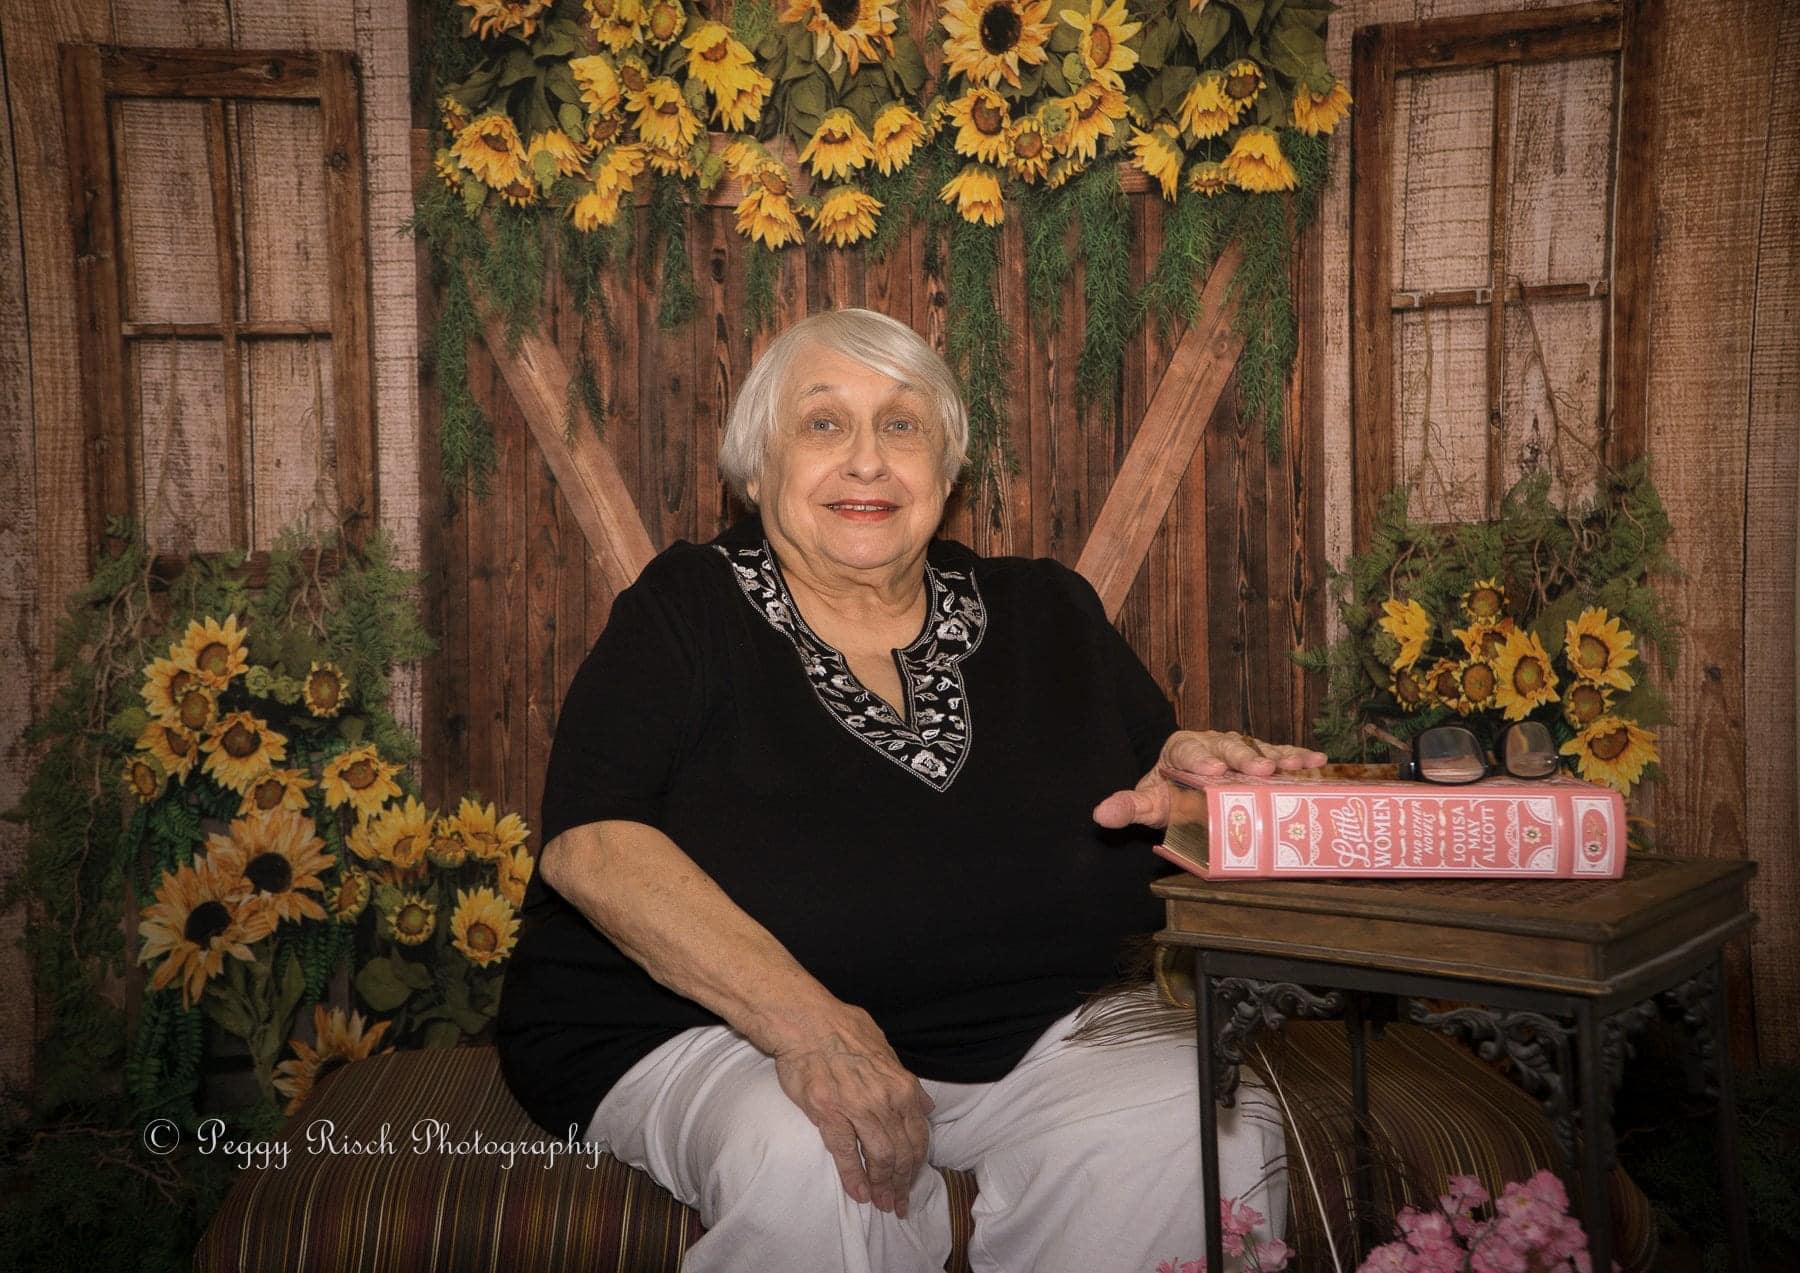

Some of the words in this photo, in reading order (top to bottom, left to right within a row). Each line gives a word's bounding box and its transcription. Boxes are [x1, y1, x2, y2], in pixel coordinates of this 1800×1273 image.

[1330, 797, 1371, 867] Little
[1372, 798, 1392, 867] WOMEN
[1411, 800, 1423, 838] OTHER
[1423, 812, 1436, 854] NOVELS
[1452, 806, 1466, 862] LOUISA
[1467, 819, 1481, 849] MAY
[1481, 806, 1496, 863] ALCOTT
[1412, 841, 1423, 865] AND
